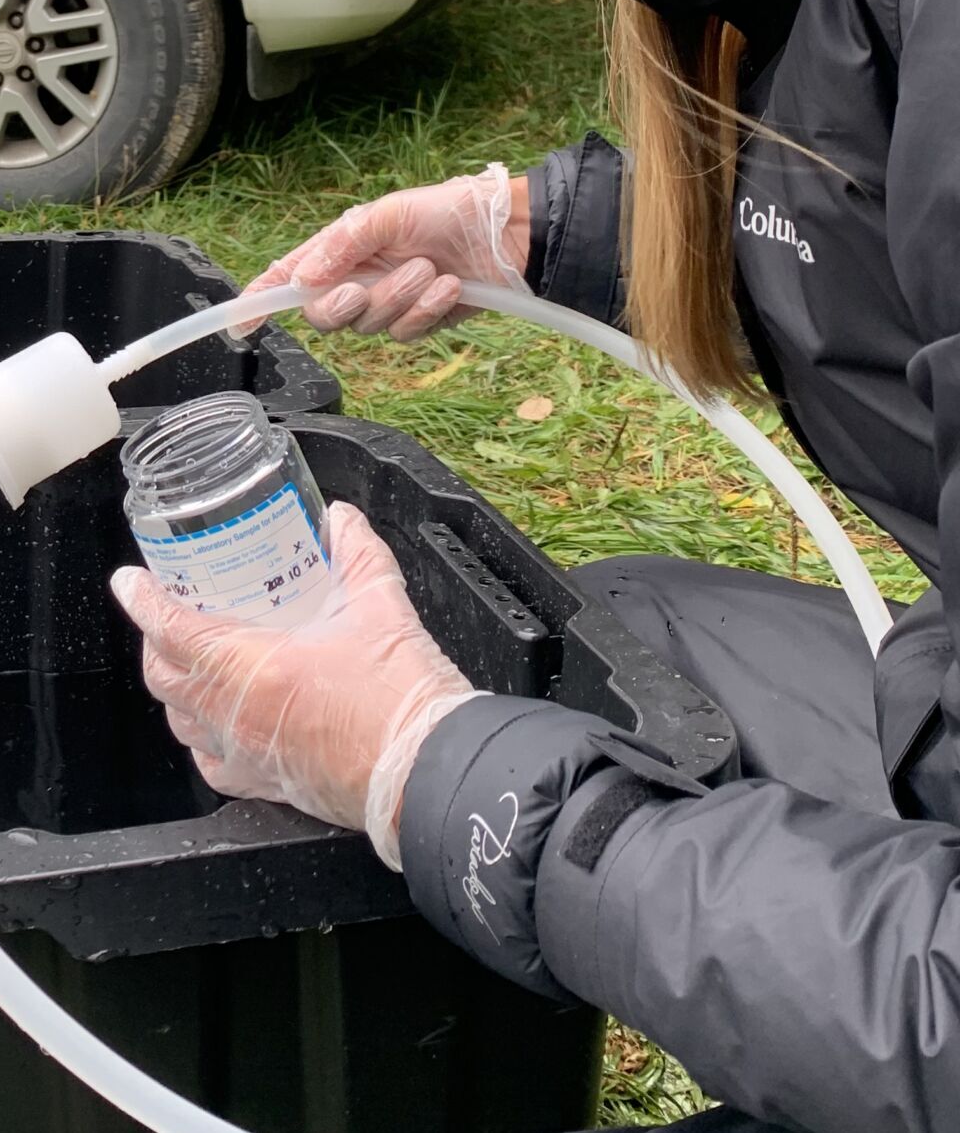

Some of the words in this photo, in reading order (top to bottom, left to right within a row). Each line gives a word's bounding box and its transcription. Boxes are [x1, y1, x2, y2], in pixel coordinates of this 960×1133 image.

[192, 538, 232, 556] Laboratory
[233, 523, 261, 541] Sample
[261, 518, 271, 528] for
[271, 499, 296, 522] Analysis
[288, 565, 302, 581] 10
[304, 552, 319, 569] 26
